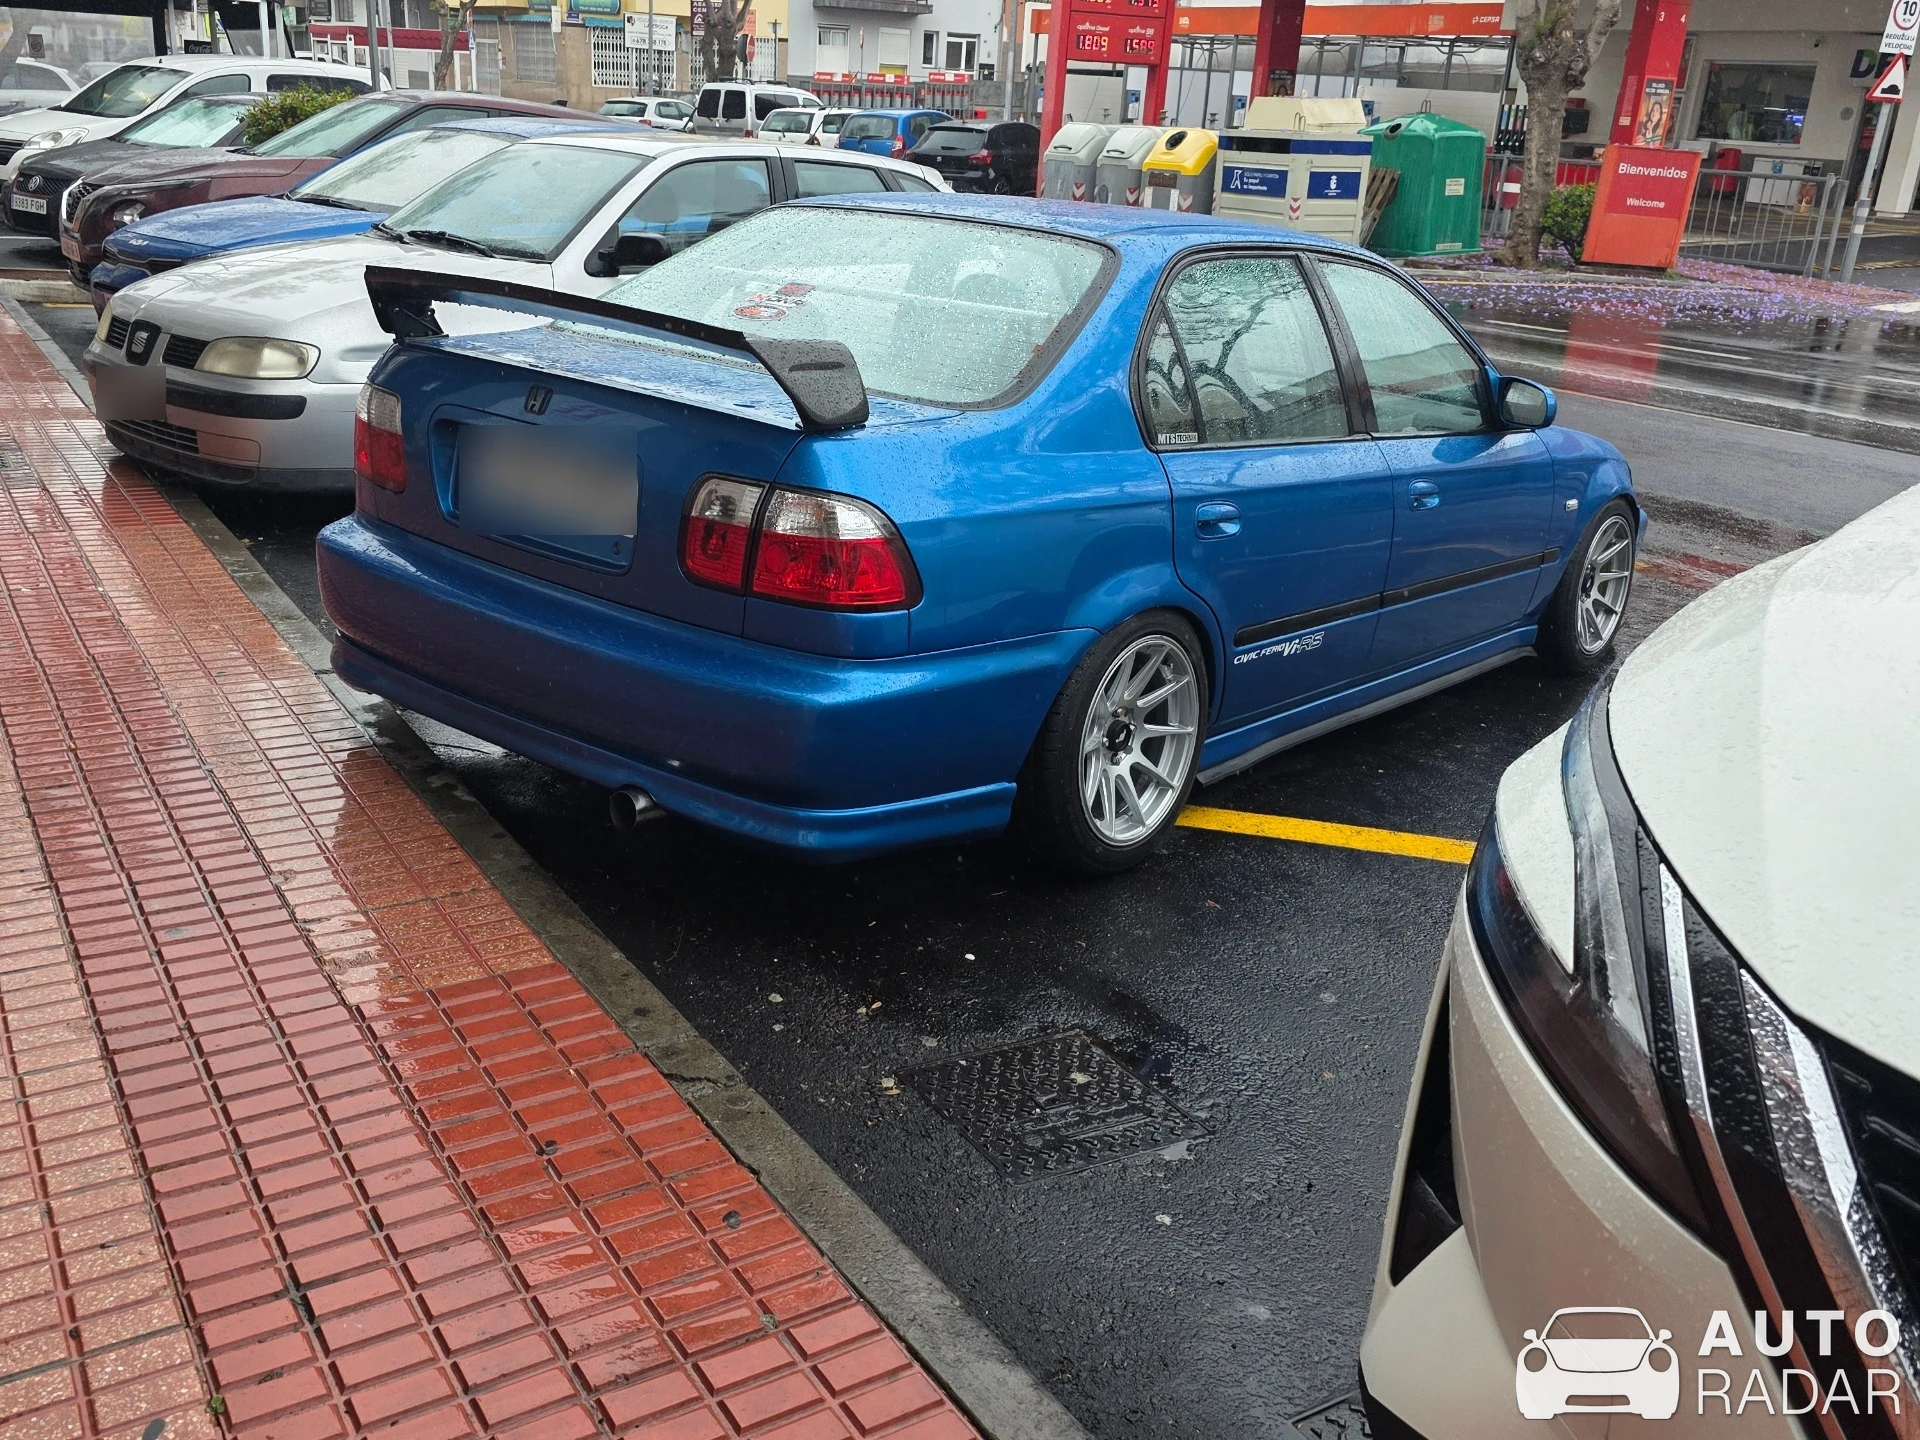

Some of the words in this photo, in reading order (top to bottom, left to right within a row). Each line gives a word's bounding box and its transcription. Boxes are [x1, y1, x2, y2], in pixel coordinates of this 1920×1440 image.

[1903, 1, 1917, 16] 10
[1659, 11, 1665, 22] 3
[1680, 13, 1686, 23] 4
[1884, 42, 1913, 50] VELOCIDAD
[1618, 162, 1688, 179] Bienvenidos
[30, 200, 45, 212] FGH
[1626, 197, 1665, 209] Welcome
[1157, 433, 1176, 445] MTS
[1233, 649, 1260, 665] CIVIC
[1260, 643, 1285, 657] FERIO
